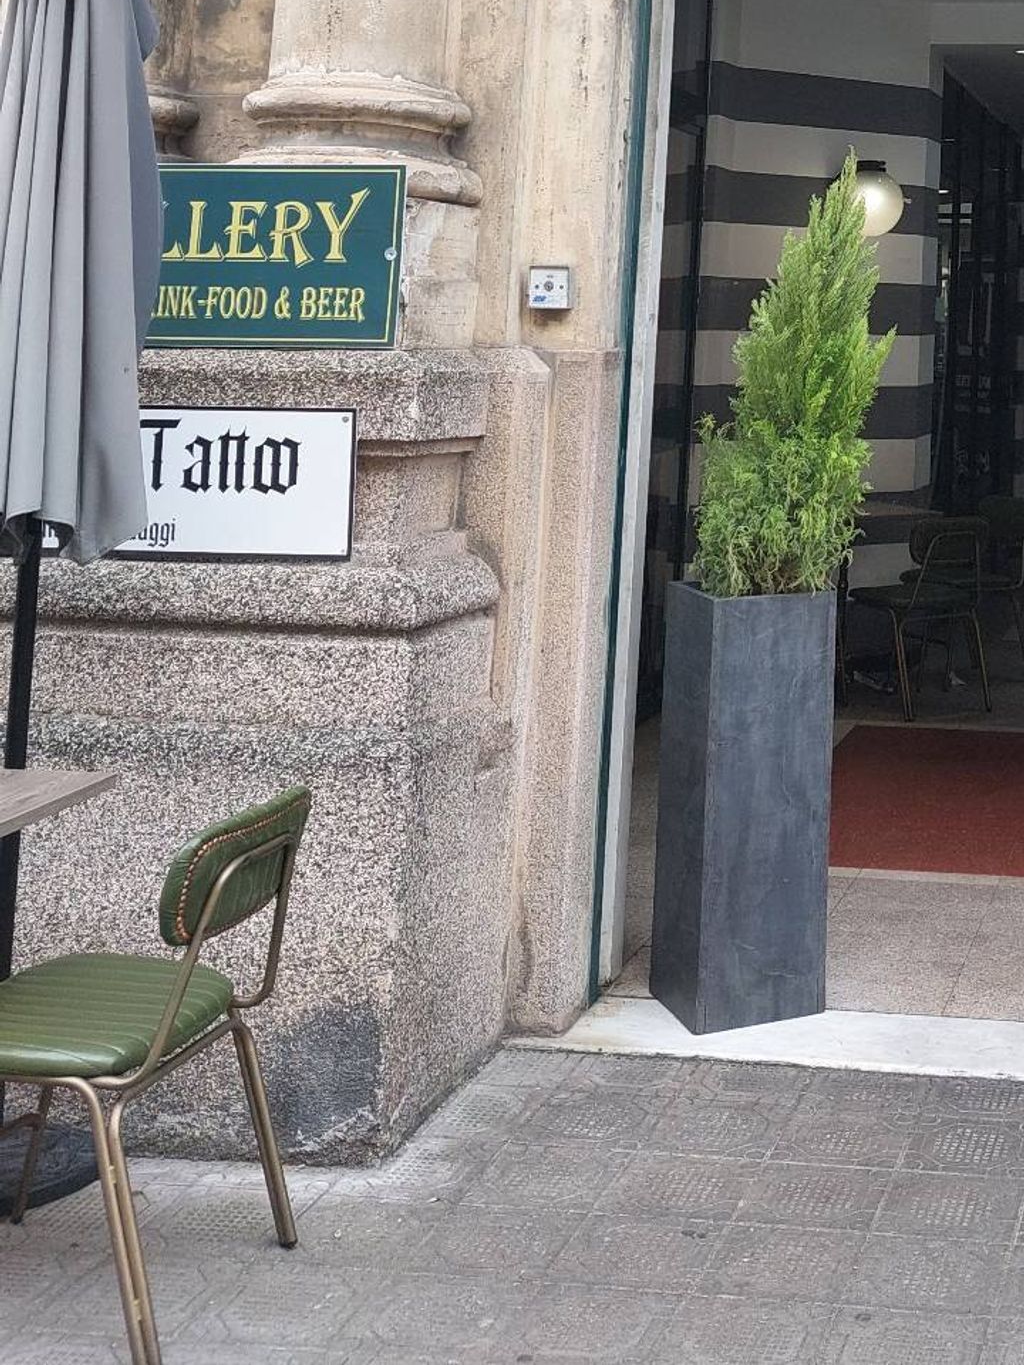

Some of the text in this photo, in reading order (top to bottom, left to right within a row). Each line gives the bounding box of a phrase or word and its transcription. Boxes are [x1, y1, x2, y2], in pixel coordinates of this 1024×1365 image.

[151, 286, 366, 323] INK-FOOD & BEER
